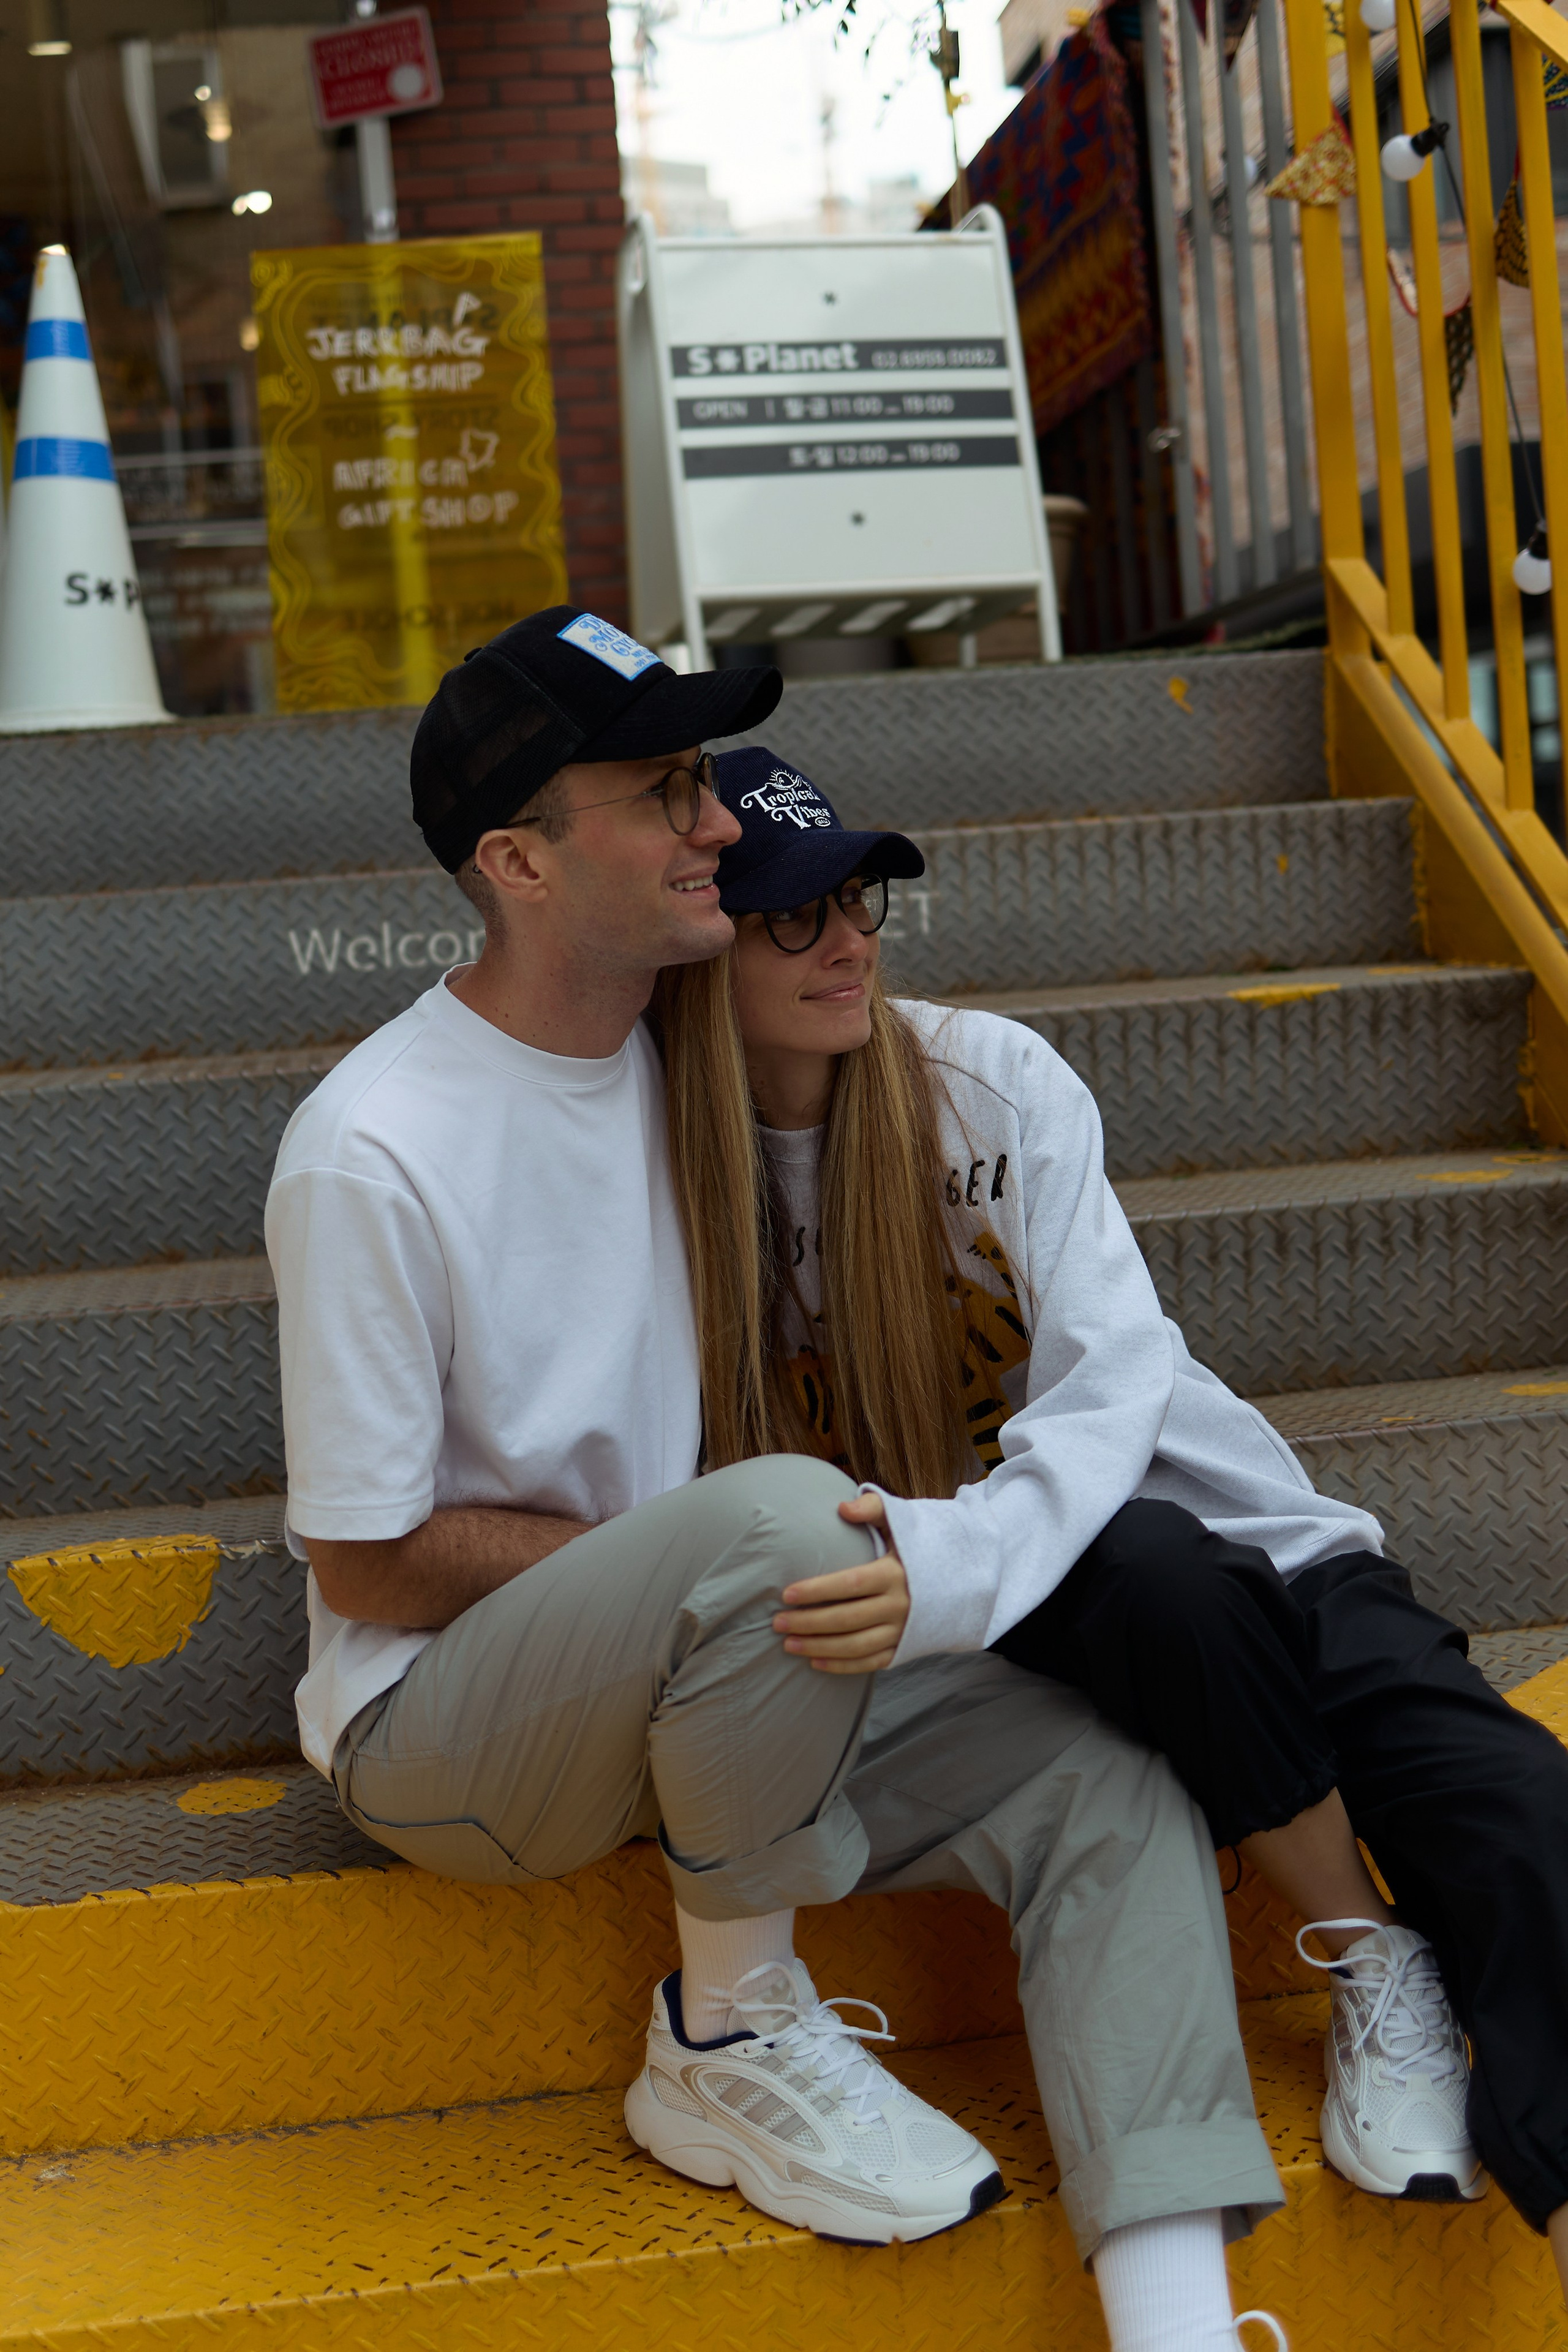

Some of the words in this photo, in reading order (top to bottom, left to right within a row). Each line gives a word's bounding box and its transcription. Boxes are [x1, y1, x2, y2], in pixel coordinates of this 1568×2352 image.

[331, 361, 484, 396] FLAGSHIP
[693, 400, 748, 420] OPEN
[334, 457, 468, 491] AFRICA
[339, 497, 415, 530] GIFT
[421, 490, 519, 528] SHOP
[741, 785, 821, 812] Tropical
[771, 804, 831, 829] Vibes
